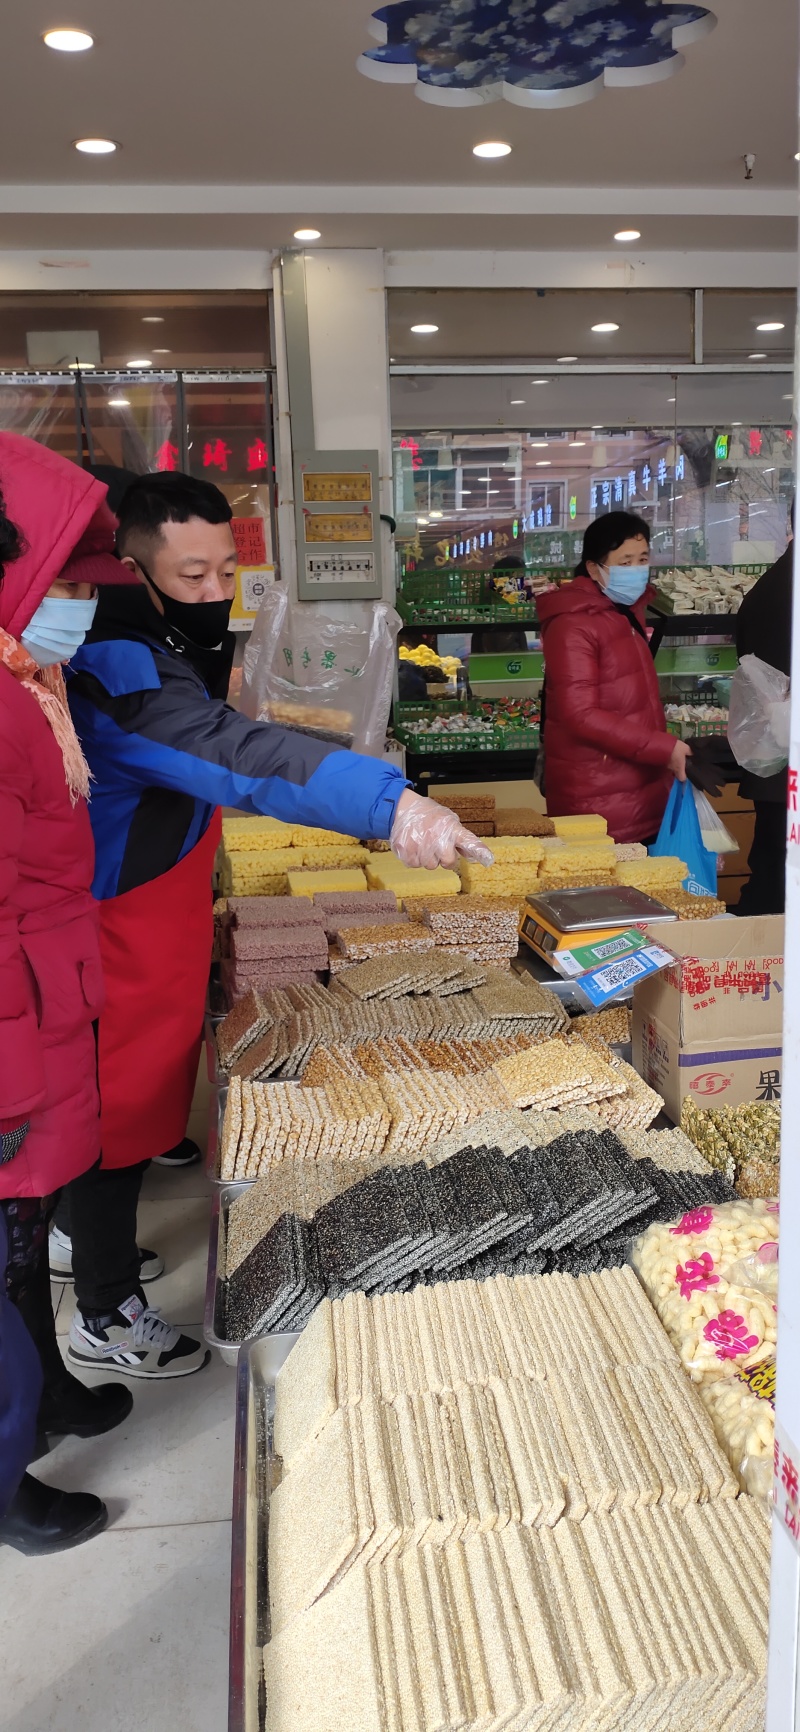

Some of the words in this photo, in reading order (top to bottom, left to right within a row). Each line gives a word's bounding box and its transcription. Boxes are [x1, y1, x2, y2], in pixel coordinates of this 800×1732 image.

[590, 454, 685, 509] 正宗清真牛羊肉
[234, 523, 260, 534] 超市
[755, 1069, 782, 1101] 果
